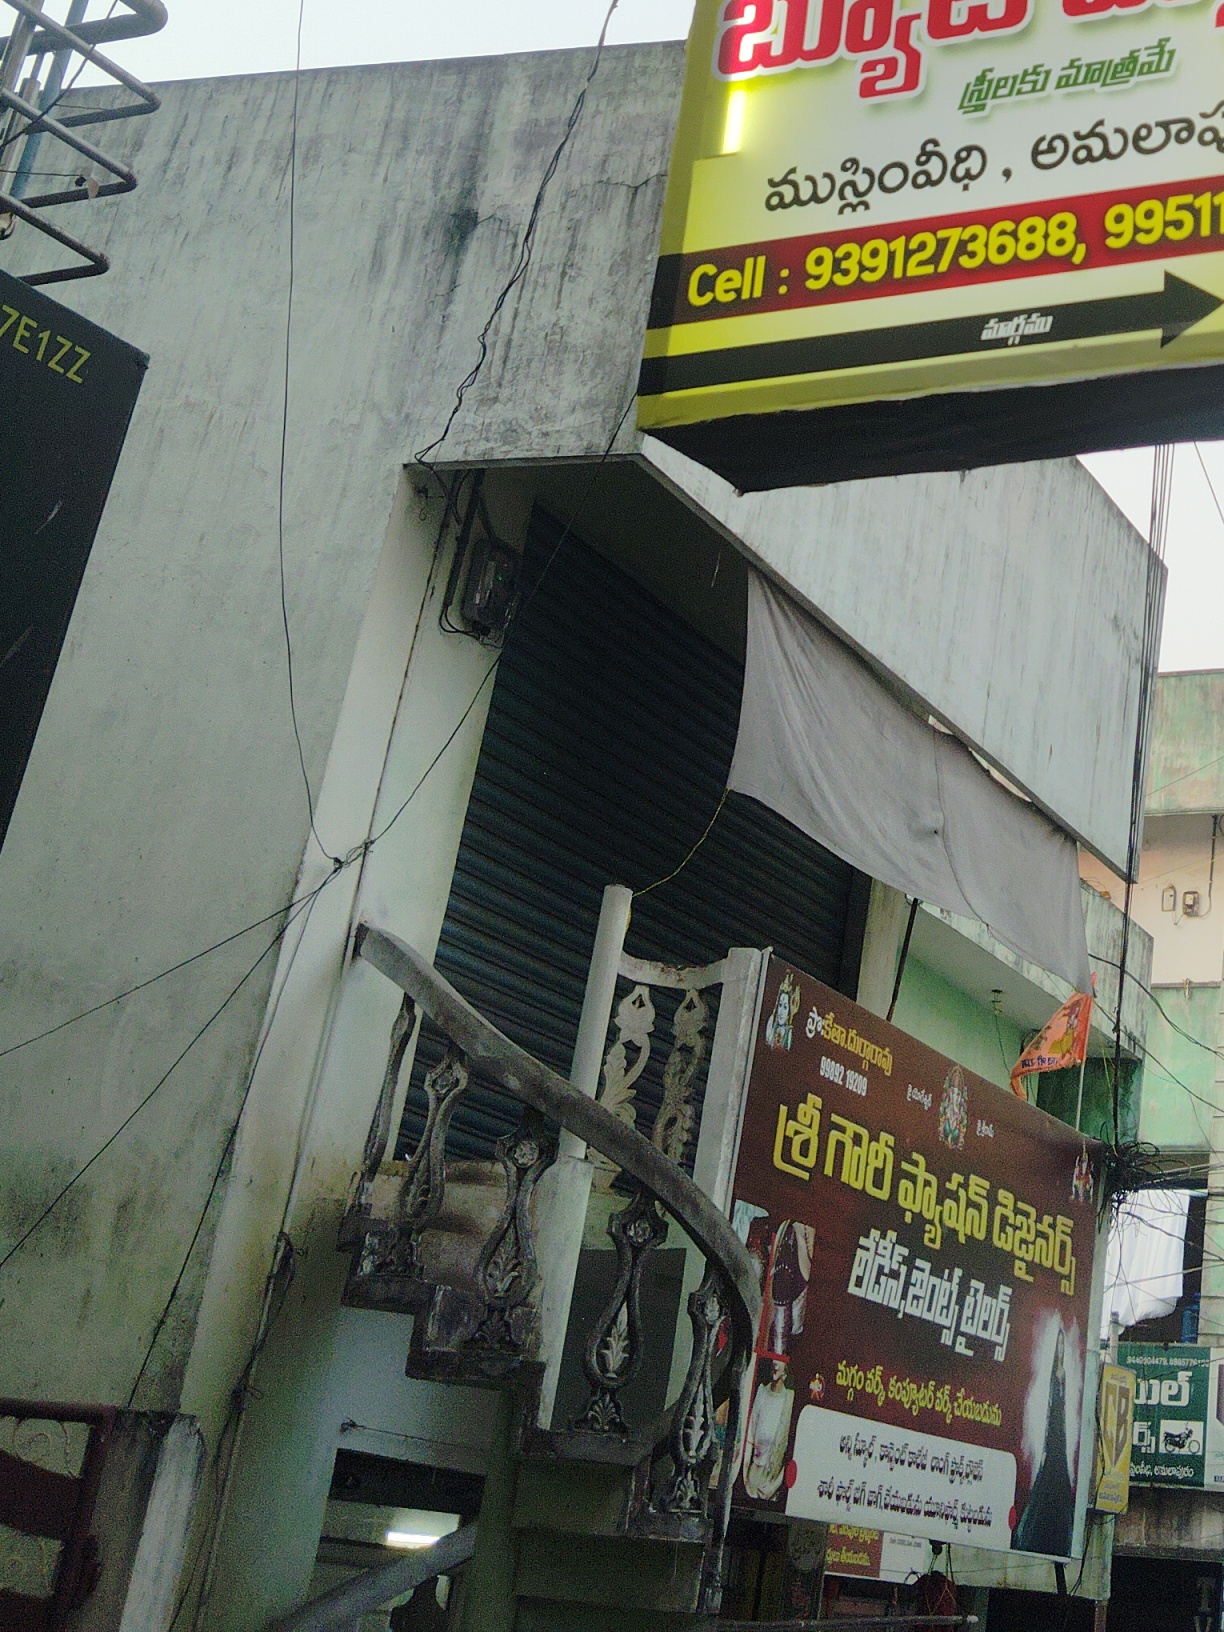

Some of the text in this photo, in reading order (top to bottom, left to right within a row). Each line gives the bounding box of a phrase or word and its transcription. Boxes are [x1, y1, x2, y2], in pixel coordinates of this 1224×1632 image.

[957, 37, 1178, 115] స్త్రీలకు మాత్రమే
[687, 255, 766, 306] Cell
[805, 211, 1087, 291] 9391273688,
[773, 1093, 1077, 1297] శ్రీ గౌరీ ఫ్యాషన్ డిజైనర్స్
